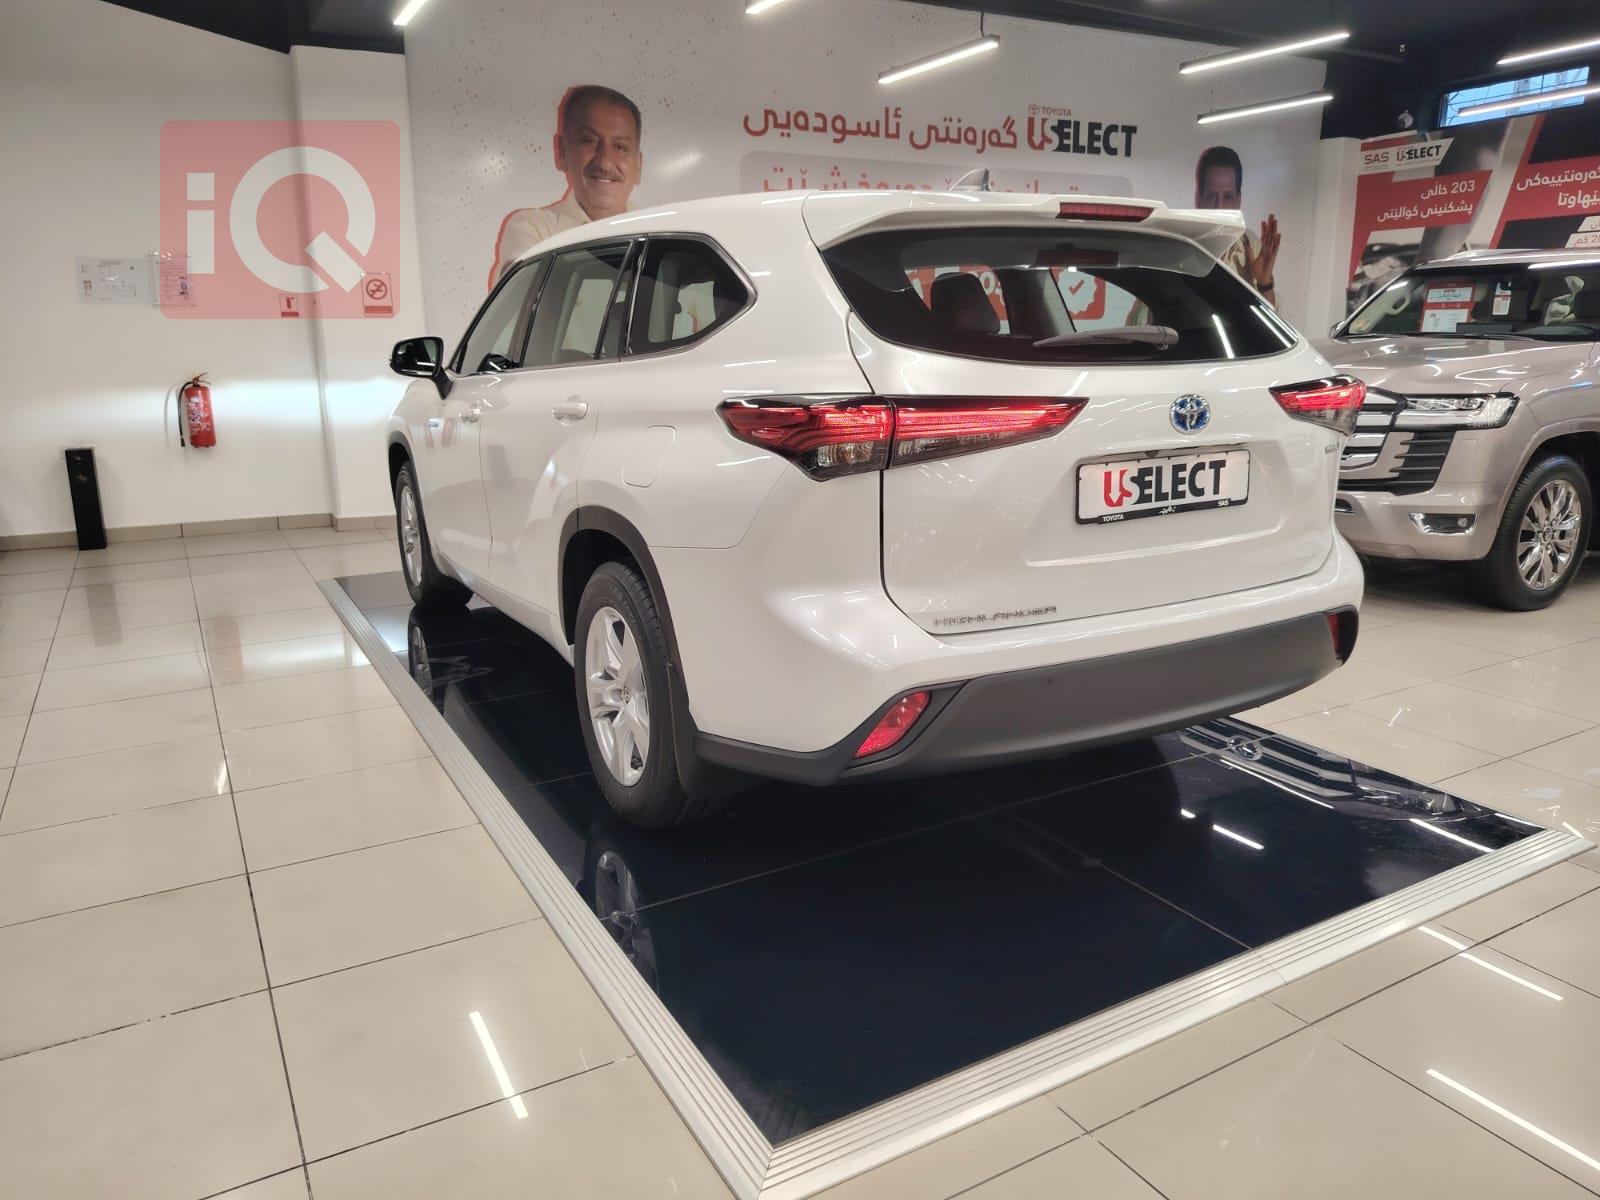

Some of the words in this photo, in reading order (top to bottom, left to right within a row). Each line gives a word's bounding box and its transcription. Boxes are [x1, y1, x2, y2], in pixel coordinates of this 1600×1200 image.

[1041, 106, 1072, 117] TOYOTA
[1027, 116, 1137, 157] USELECT
[1364, 152, 1389, 165] SAS
[1451, 180, 1475, 194] 203
[1103, 459, 1226, 508] USELECT
[1103, 513, 1124, 522] TOYOTA
